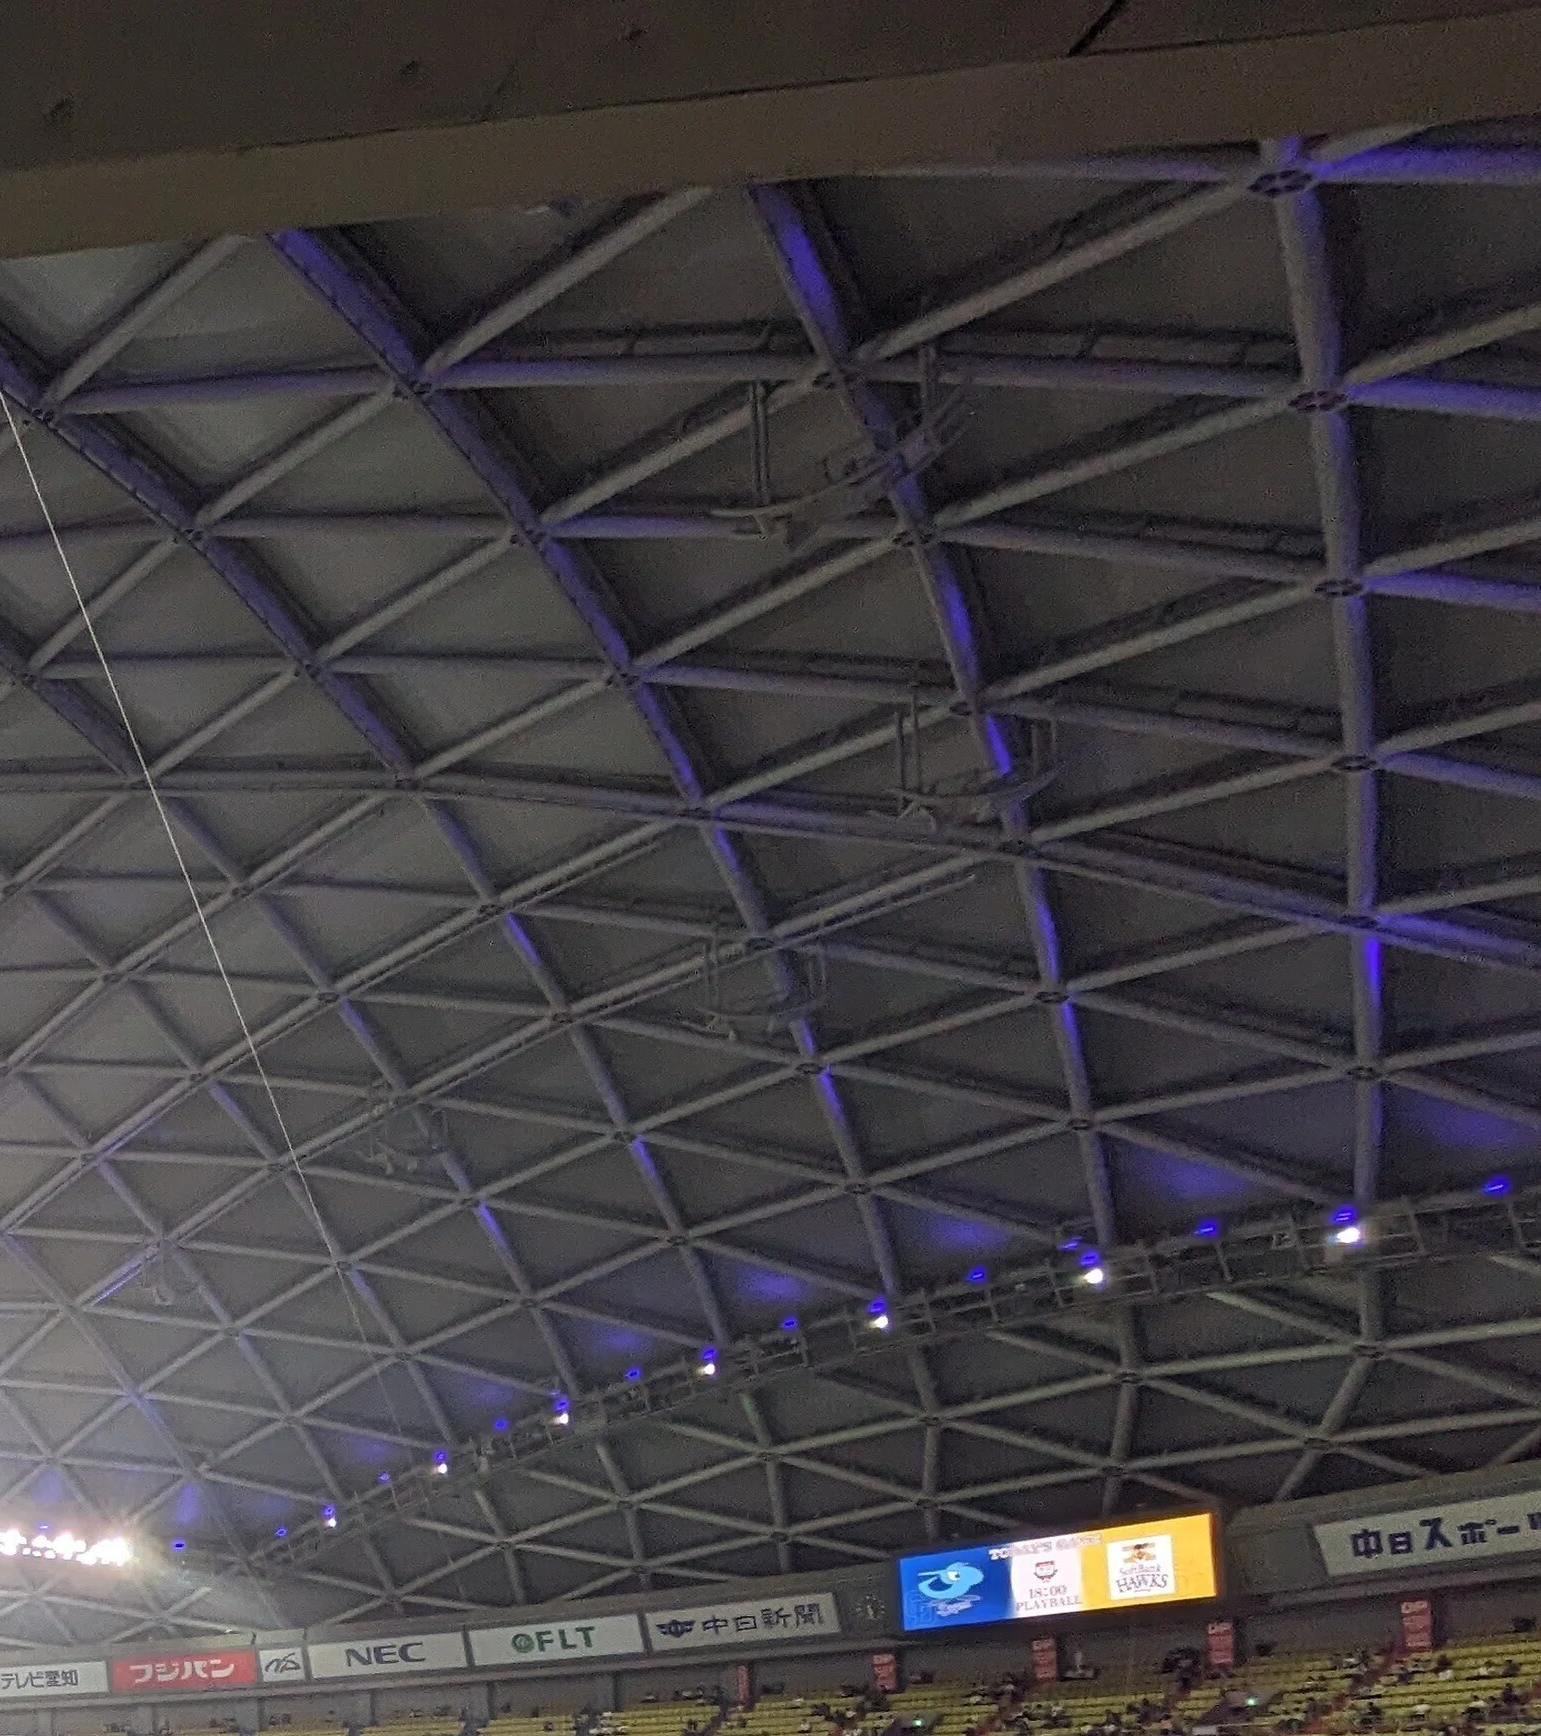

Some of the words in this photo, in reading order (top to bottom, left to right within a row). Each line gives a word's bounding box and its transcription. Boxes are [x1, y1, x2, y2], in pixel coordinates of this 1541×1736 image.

[702, 1602, 822, 1635] 中日新聞
[344, 1642, 427, 1668] NEC
[0, 1669, 79, 1690] テレビ愛知
[129, 1659, 235, 1684] フジパン
